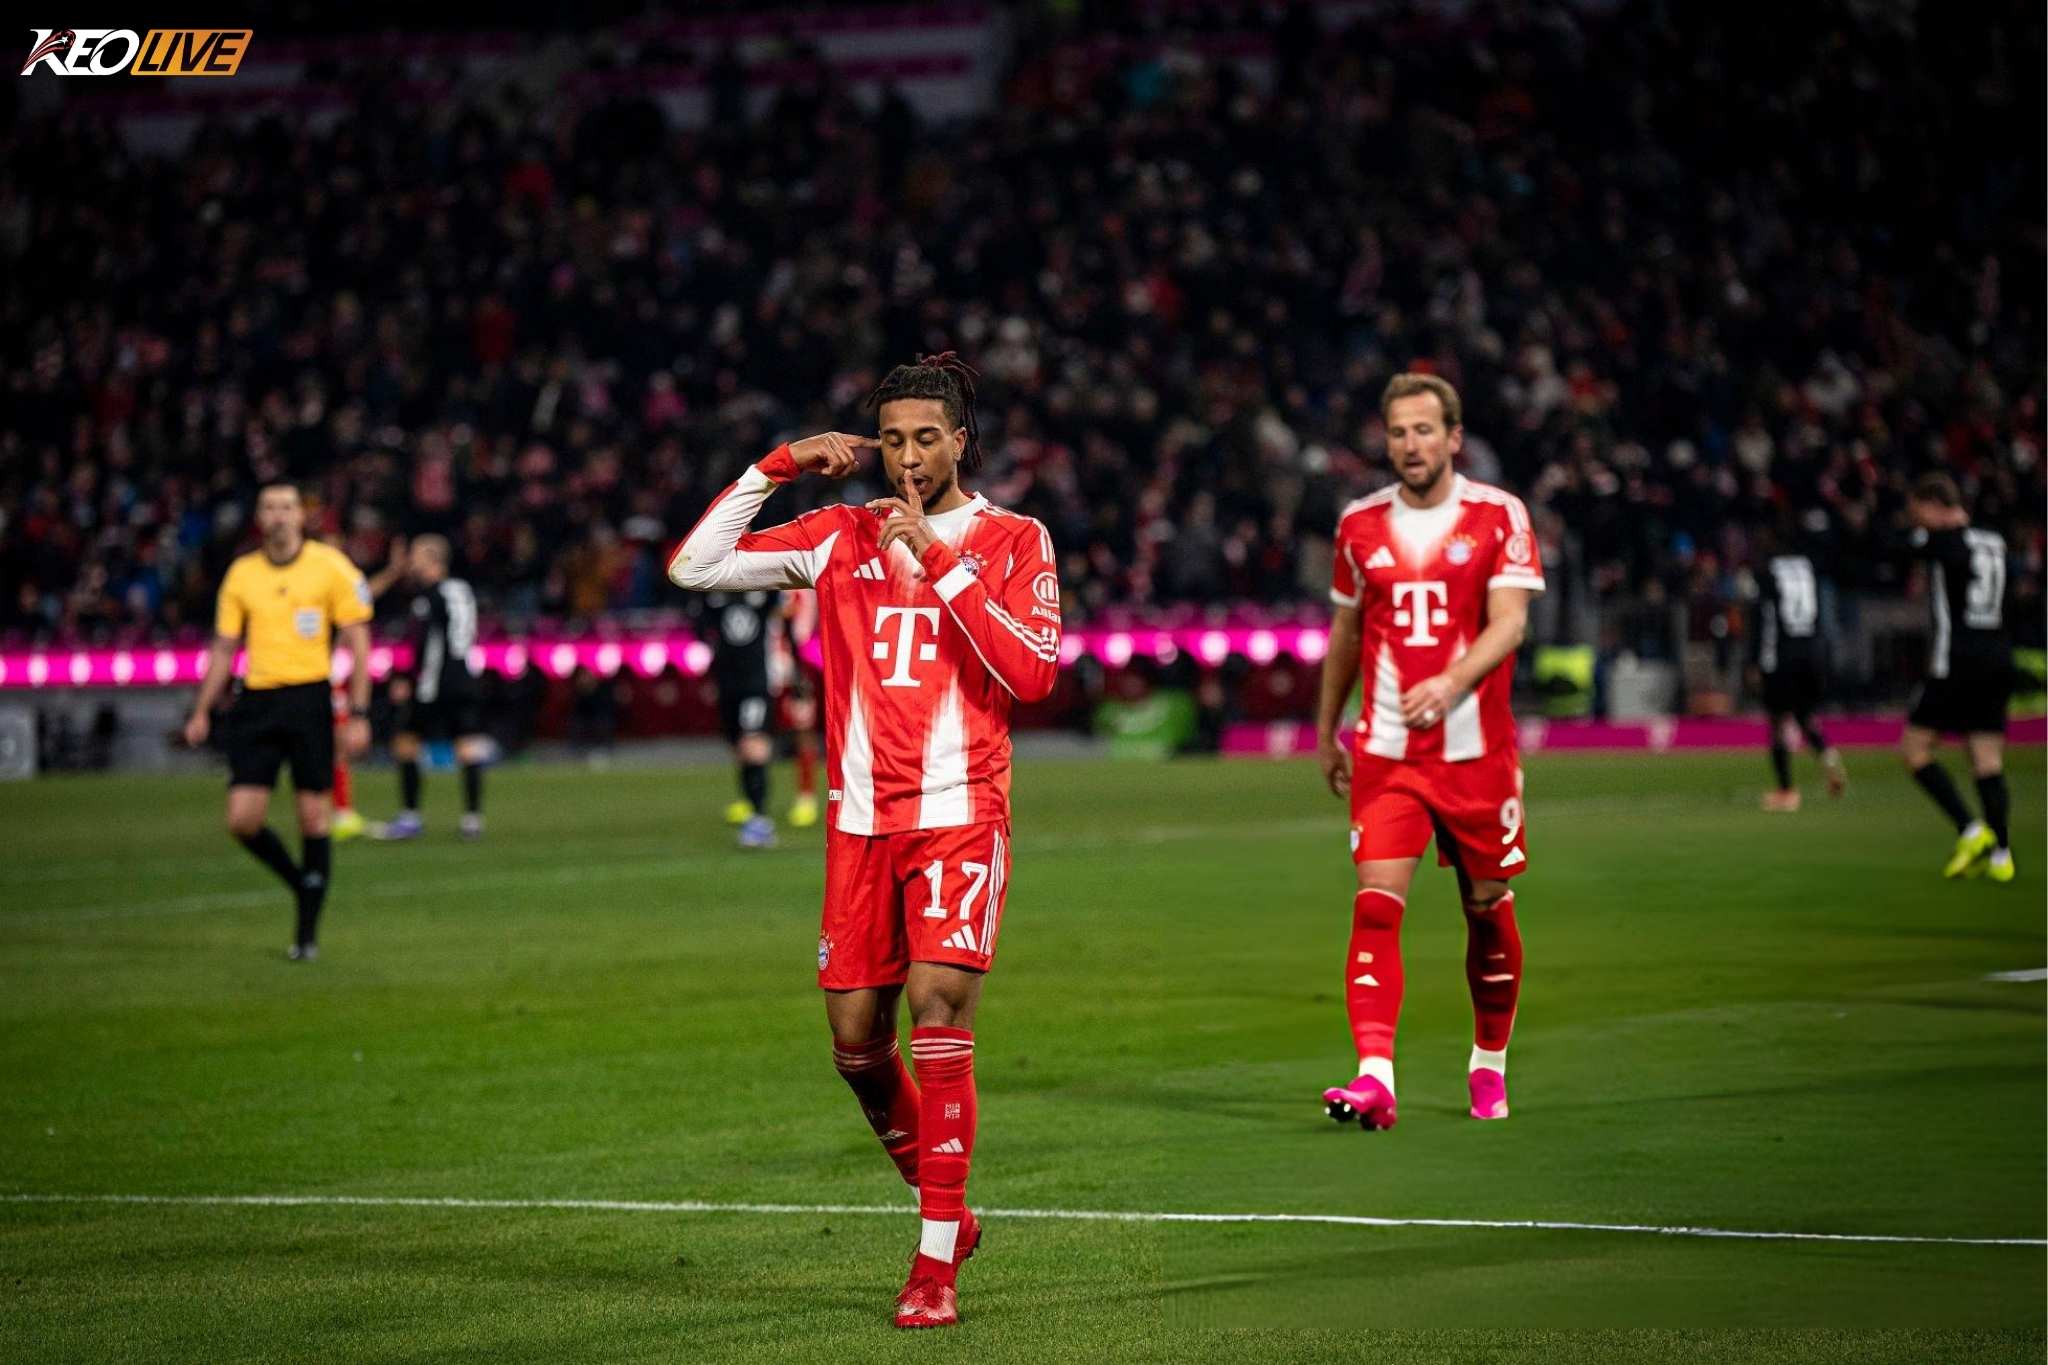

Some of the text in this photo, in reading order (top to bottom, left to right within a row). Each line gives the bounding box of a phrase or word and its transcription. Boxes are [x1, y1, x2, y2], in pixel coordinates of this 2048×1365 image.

[1392, 581, 1449, 647] T
[873, 606, 941, 688] T
[1500, 797, 1521, 844] 9
[923, 860, 988, 920] 17
